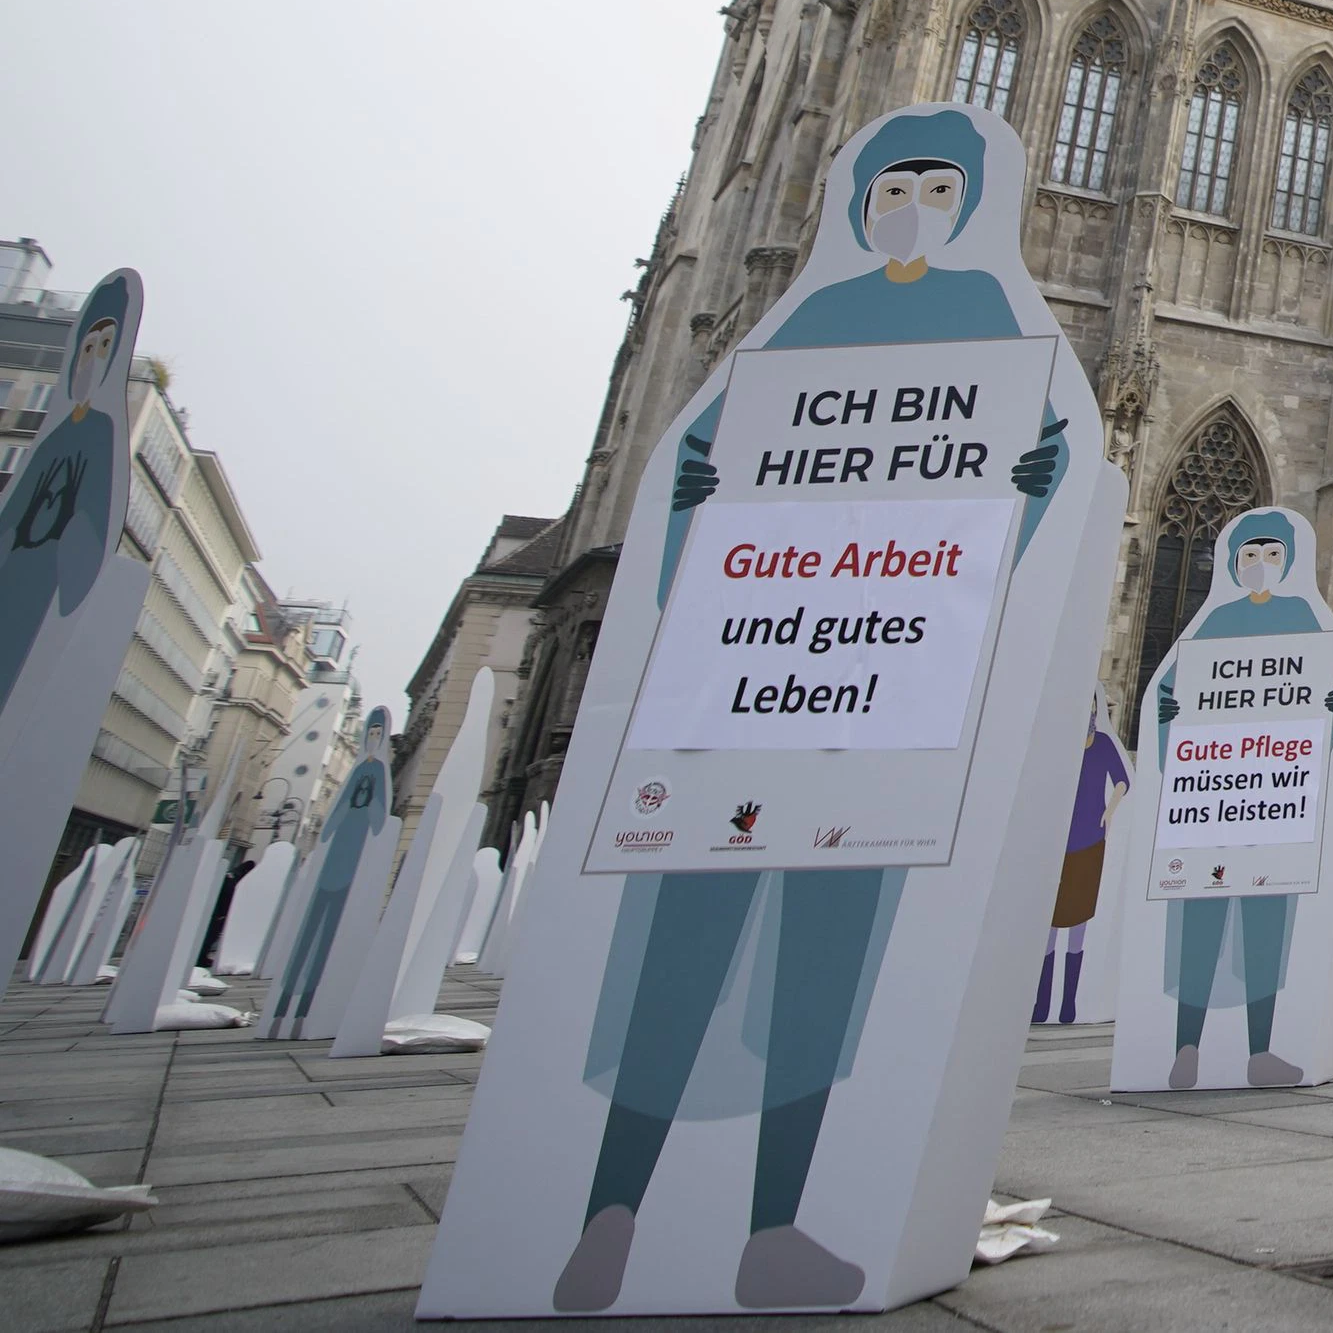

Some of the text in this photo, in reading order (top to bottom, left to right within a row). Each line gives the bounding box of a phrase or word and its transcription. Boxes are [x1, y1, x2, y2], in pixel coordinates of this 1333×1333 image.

[792, 385, 978, 427] ICH BIN
[755, 434, 988, 486] HIER FÜR
[723, 540, 962, 578] Gute Arbeit
[721, 607, 926, 654] und gutes
[1212, 656, 1303, 679] ICH BIN
[731, 674, 879, 713] Leben!
[1198, 682, 1312, 710] HIER FÜR
[1176, 735, 1313, 762] Gute Pflege
[1173, 765, 1310, 792] müssen wir
[1168, 795, 1306, 824] uns leisten!
[615, 830, 674, 845] younion
[728, 832, 752, 844] GÖD
[899, 838, 917, 848] FÜR
[917, 838, 936, 847] WIEN
